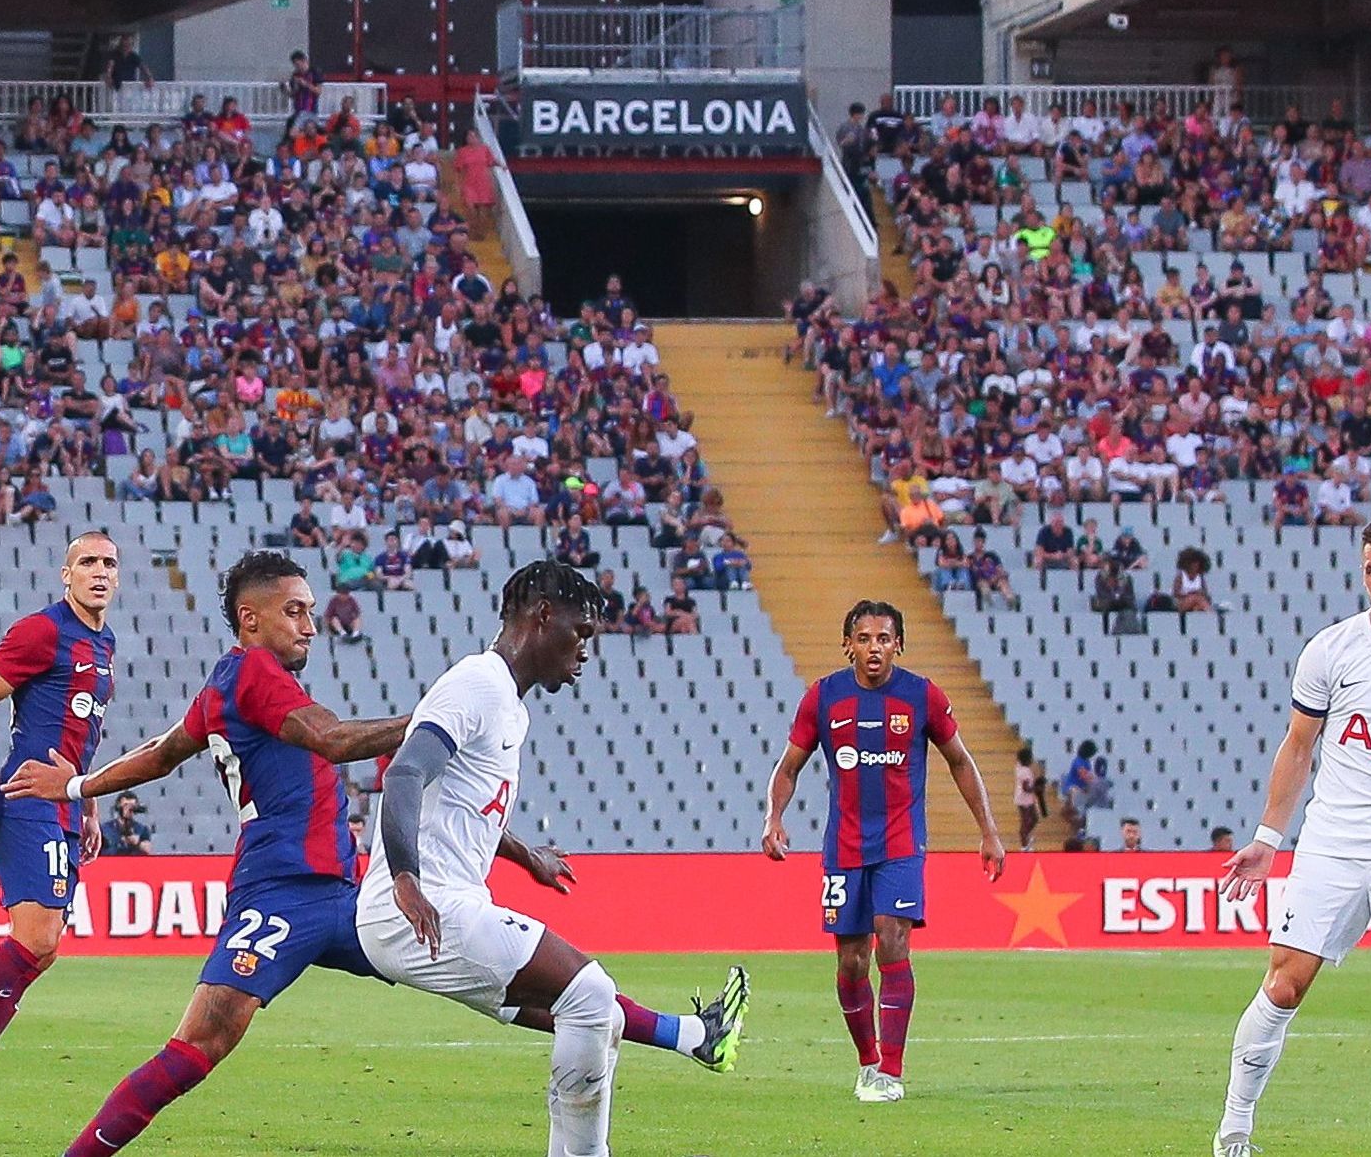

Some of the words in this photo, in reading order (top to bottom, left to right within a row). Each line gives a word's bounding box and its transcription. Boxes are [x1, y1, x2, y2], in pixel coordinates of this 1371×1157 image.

[532, 99, 796, 135] BARCELONA
[860, 750, 906, 767] Spotify
[43, 840, 69, 878] 18
[821, 874, 847, 908] 23
[1104, 878, 1284, 933] ESTR
[226, 909, 293, 961] 22
